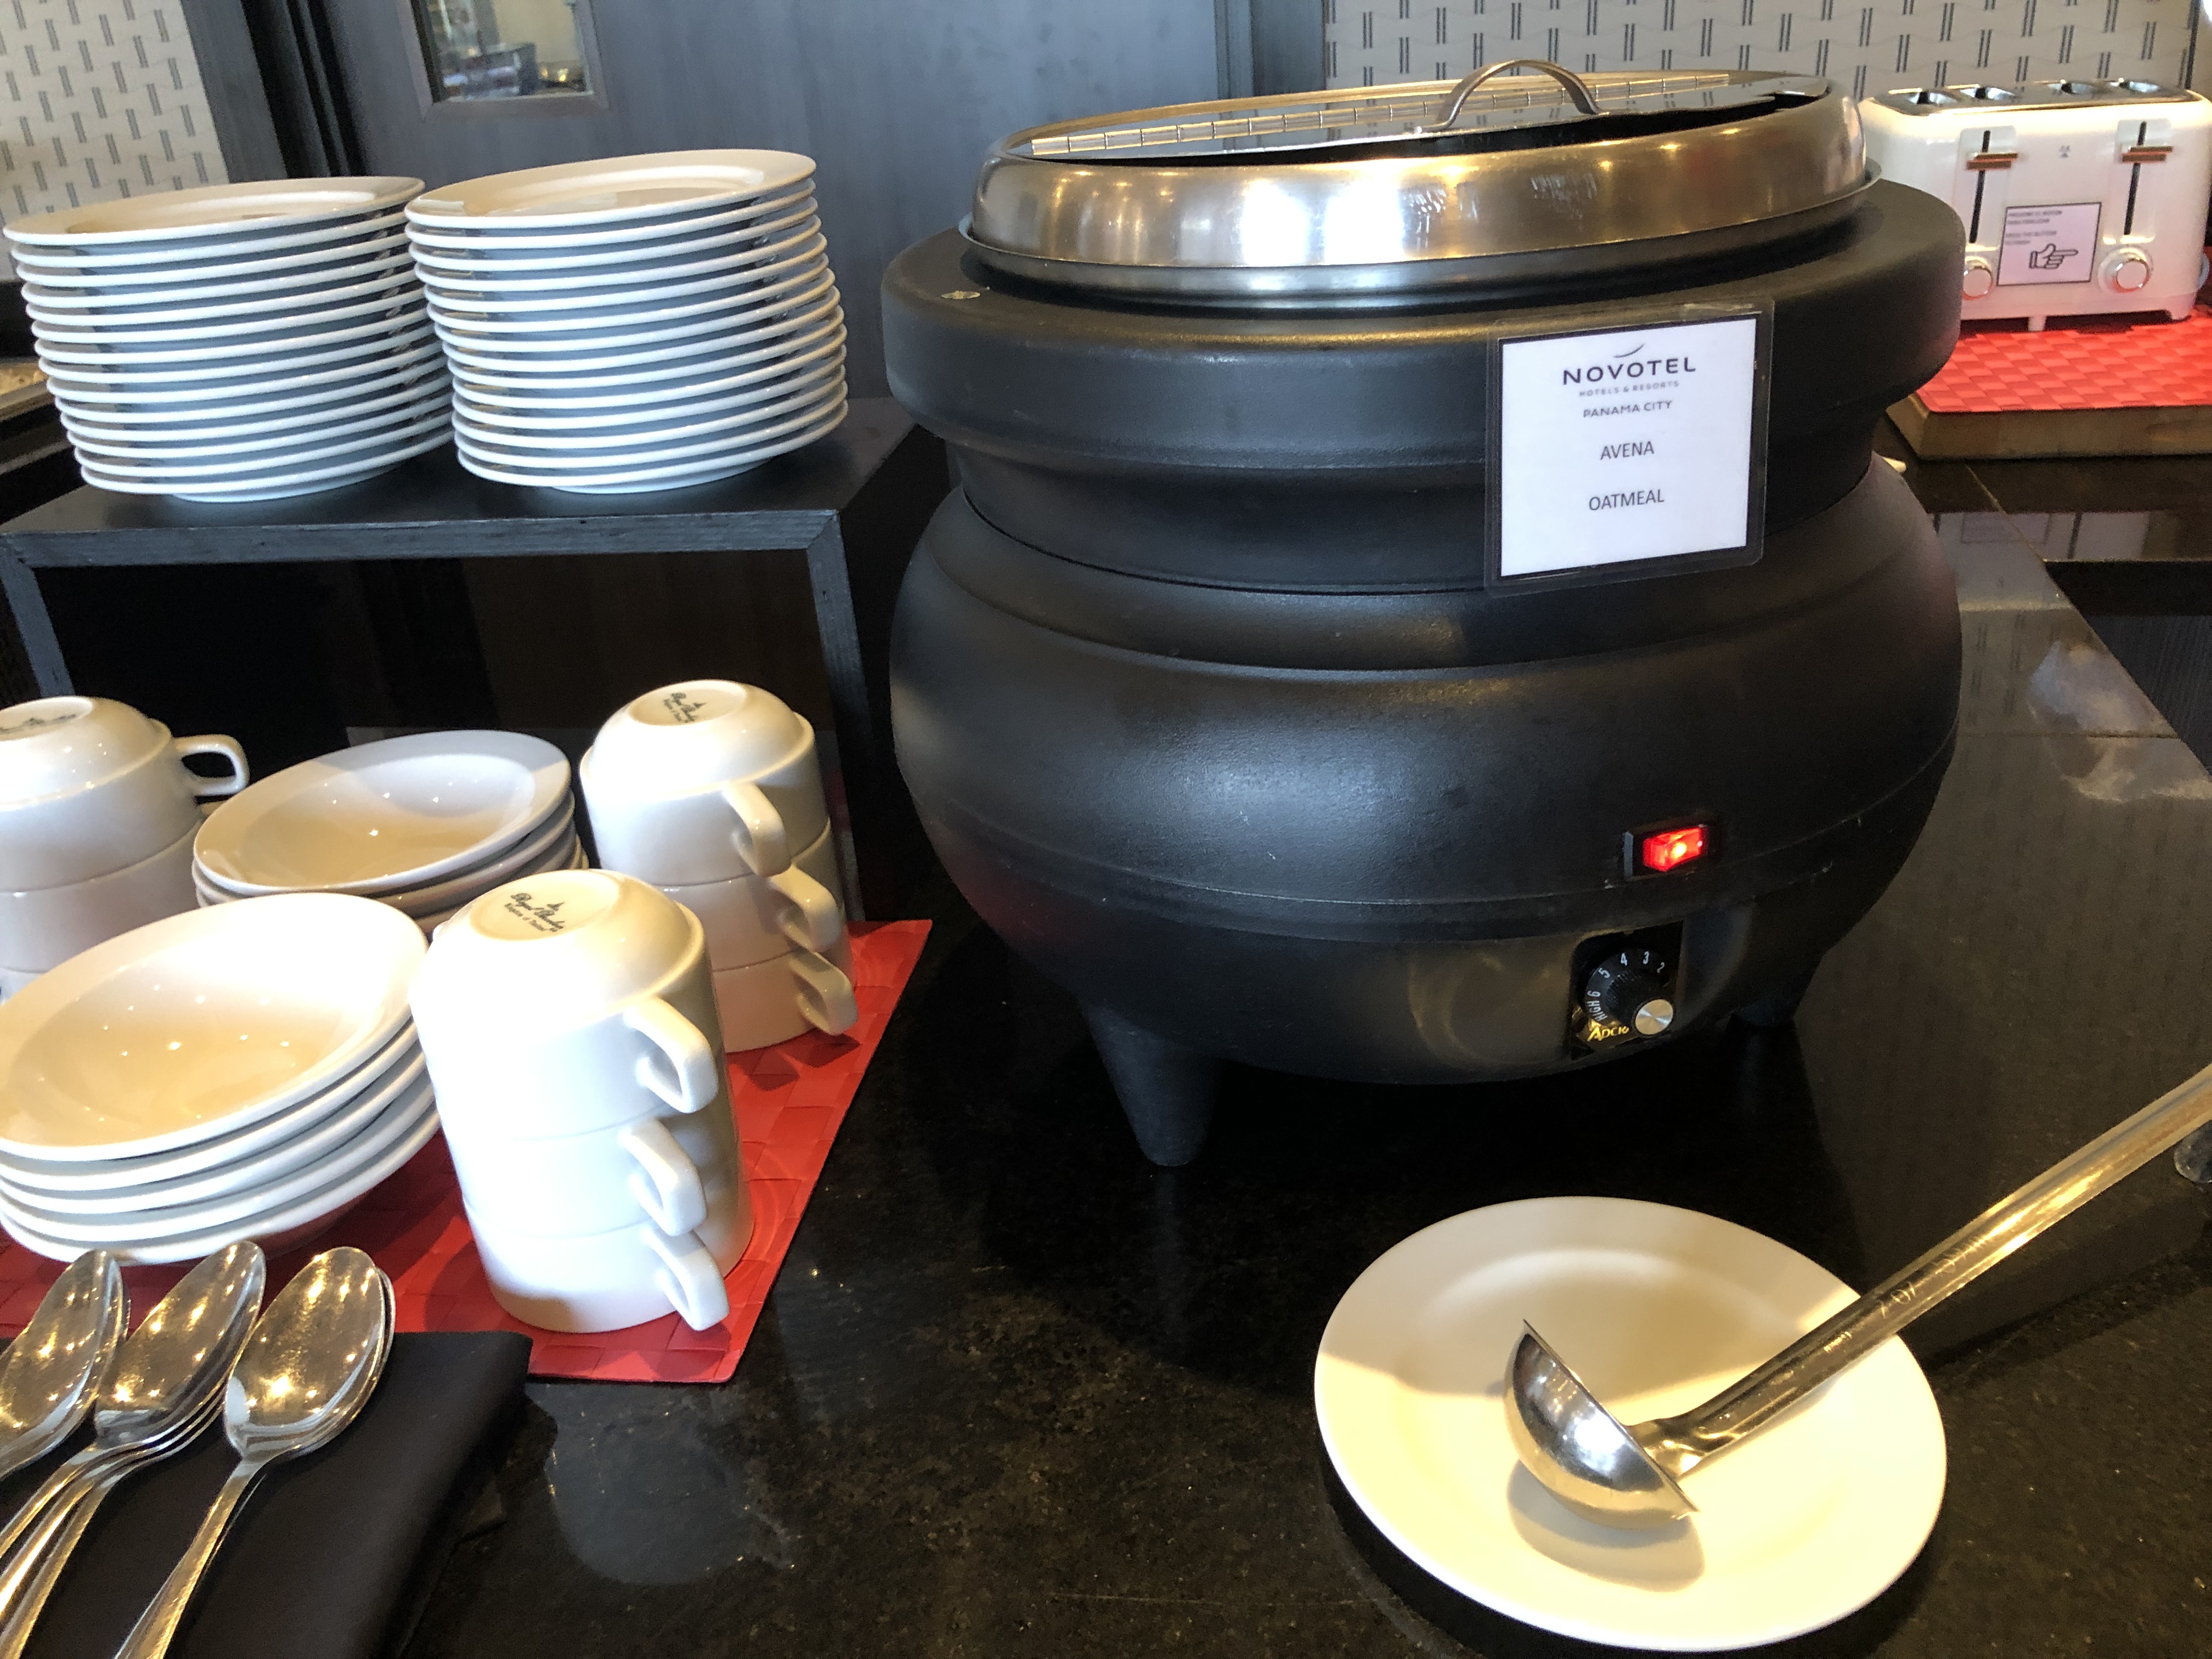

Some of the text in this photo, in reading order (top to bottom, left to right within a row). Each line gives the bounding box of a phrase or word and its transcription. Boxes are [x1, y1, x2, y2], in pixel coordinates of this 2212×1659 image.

[1563, 357, 1696, 385] NOVOTEL
[1579, 387, 1619, 397] HOTELS
[1632, 381, 1679, 391] RESORTS
[1583, 400, 1673, 418] PANAMA CITY
[1600, 441, 1655, 460] AVENA
[1588, 489, 1665, 511] OATMEAL
[1587, 1000, 1608, 1022] HIGH
[1598, 967, 1610, 979] 5
[1620, 952, 1628, 967] 4
[1642, 950, 1650, 965] 3
